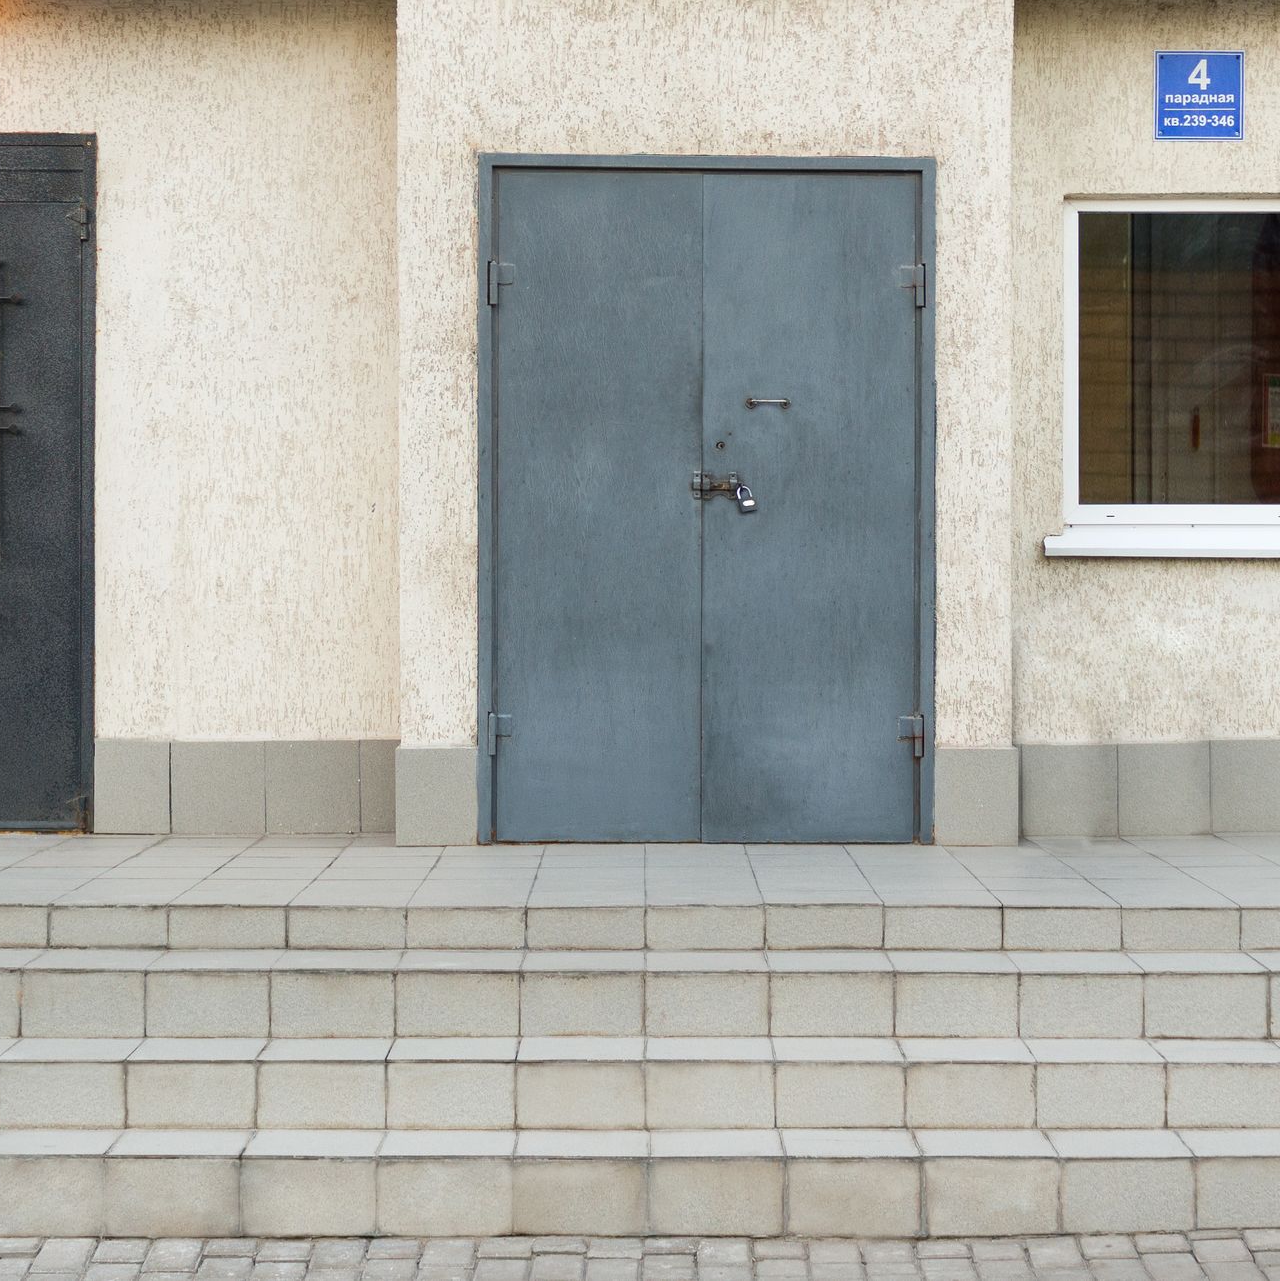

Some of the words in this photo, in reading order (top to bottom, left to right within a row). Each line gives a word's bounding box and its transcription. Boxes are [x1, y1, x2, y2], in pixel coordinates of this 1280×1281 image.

[1188, 59, 1211, 90] 4
[1165, 93, 1235, 106] парадная
[1164, 114, 1235, 127] кв.239-346
